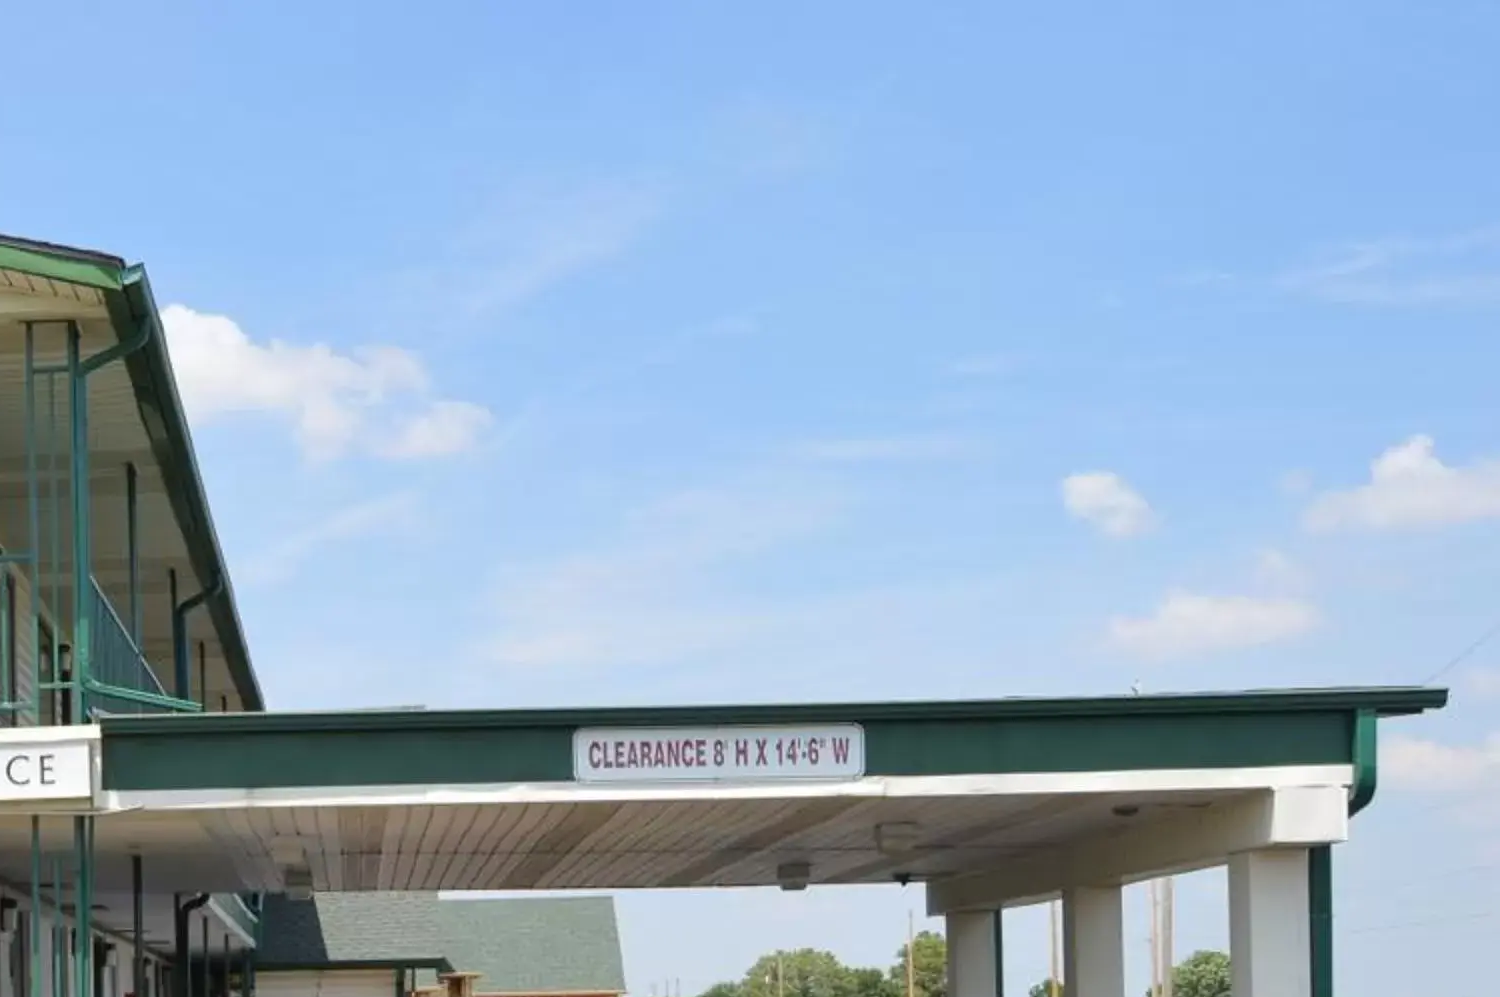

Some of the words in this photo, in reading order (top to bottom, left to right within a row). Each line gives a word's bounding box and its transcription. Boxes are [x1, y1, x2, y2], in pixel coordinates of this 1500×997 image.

[589, 740, 707, 769] CLEARANCE
[735, 740, 749, 766] H
[755, 739, 768, 765] X
[832, 738, 850, 764] W
